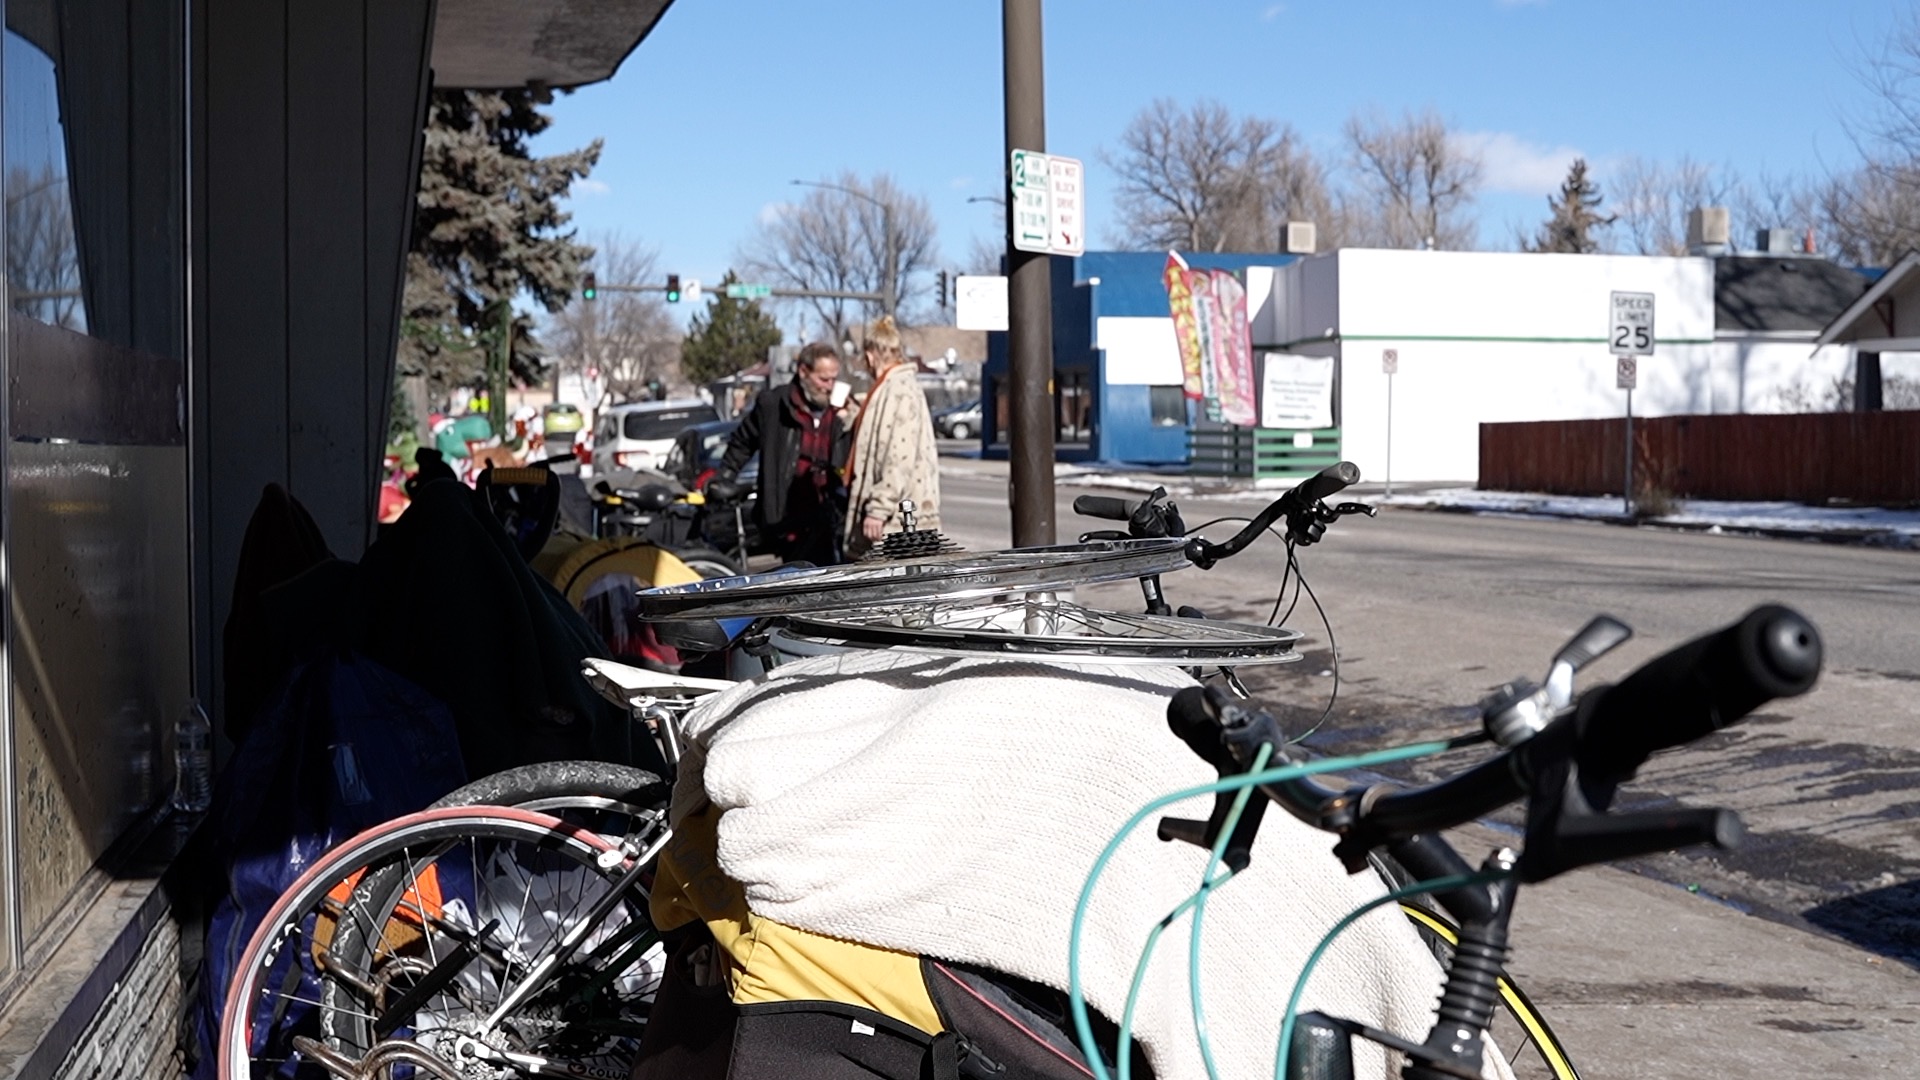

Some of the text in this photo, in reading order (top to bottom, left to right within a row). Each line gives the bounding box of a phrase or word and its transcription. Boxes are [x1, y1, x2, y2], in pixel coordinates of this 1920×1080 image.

[1015, 158, 1025, 183] 2
[1065, 167, 1076, 177] NOT
[1055, 181, 1075, 193] BLOCK
[1056, 197, 1075, 210] DRIVE
[1615, 297, 1652, 310] SPEED
[1617, 311, 1647, 323] LIMIT
[1614, 325, 1650, 349] 25
